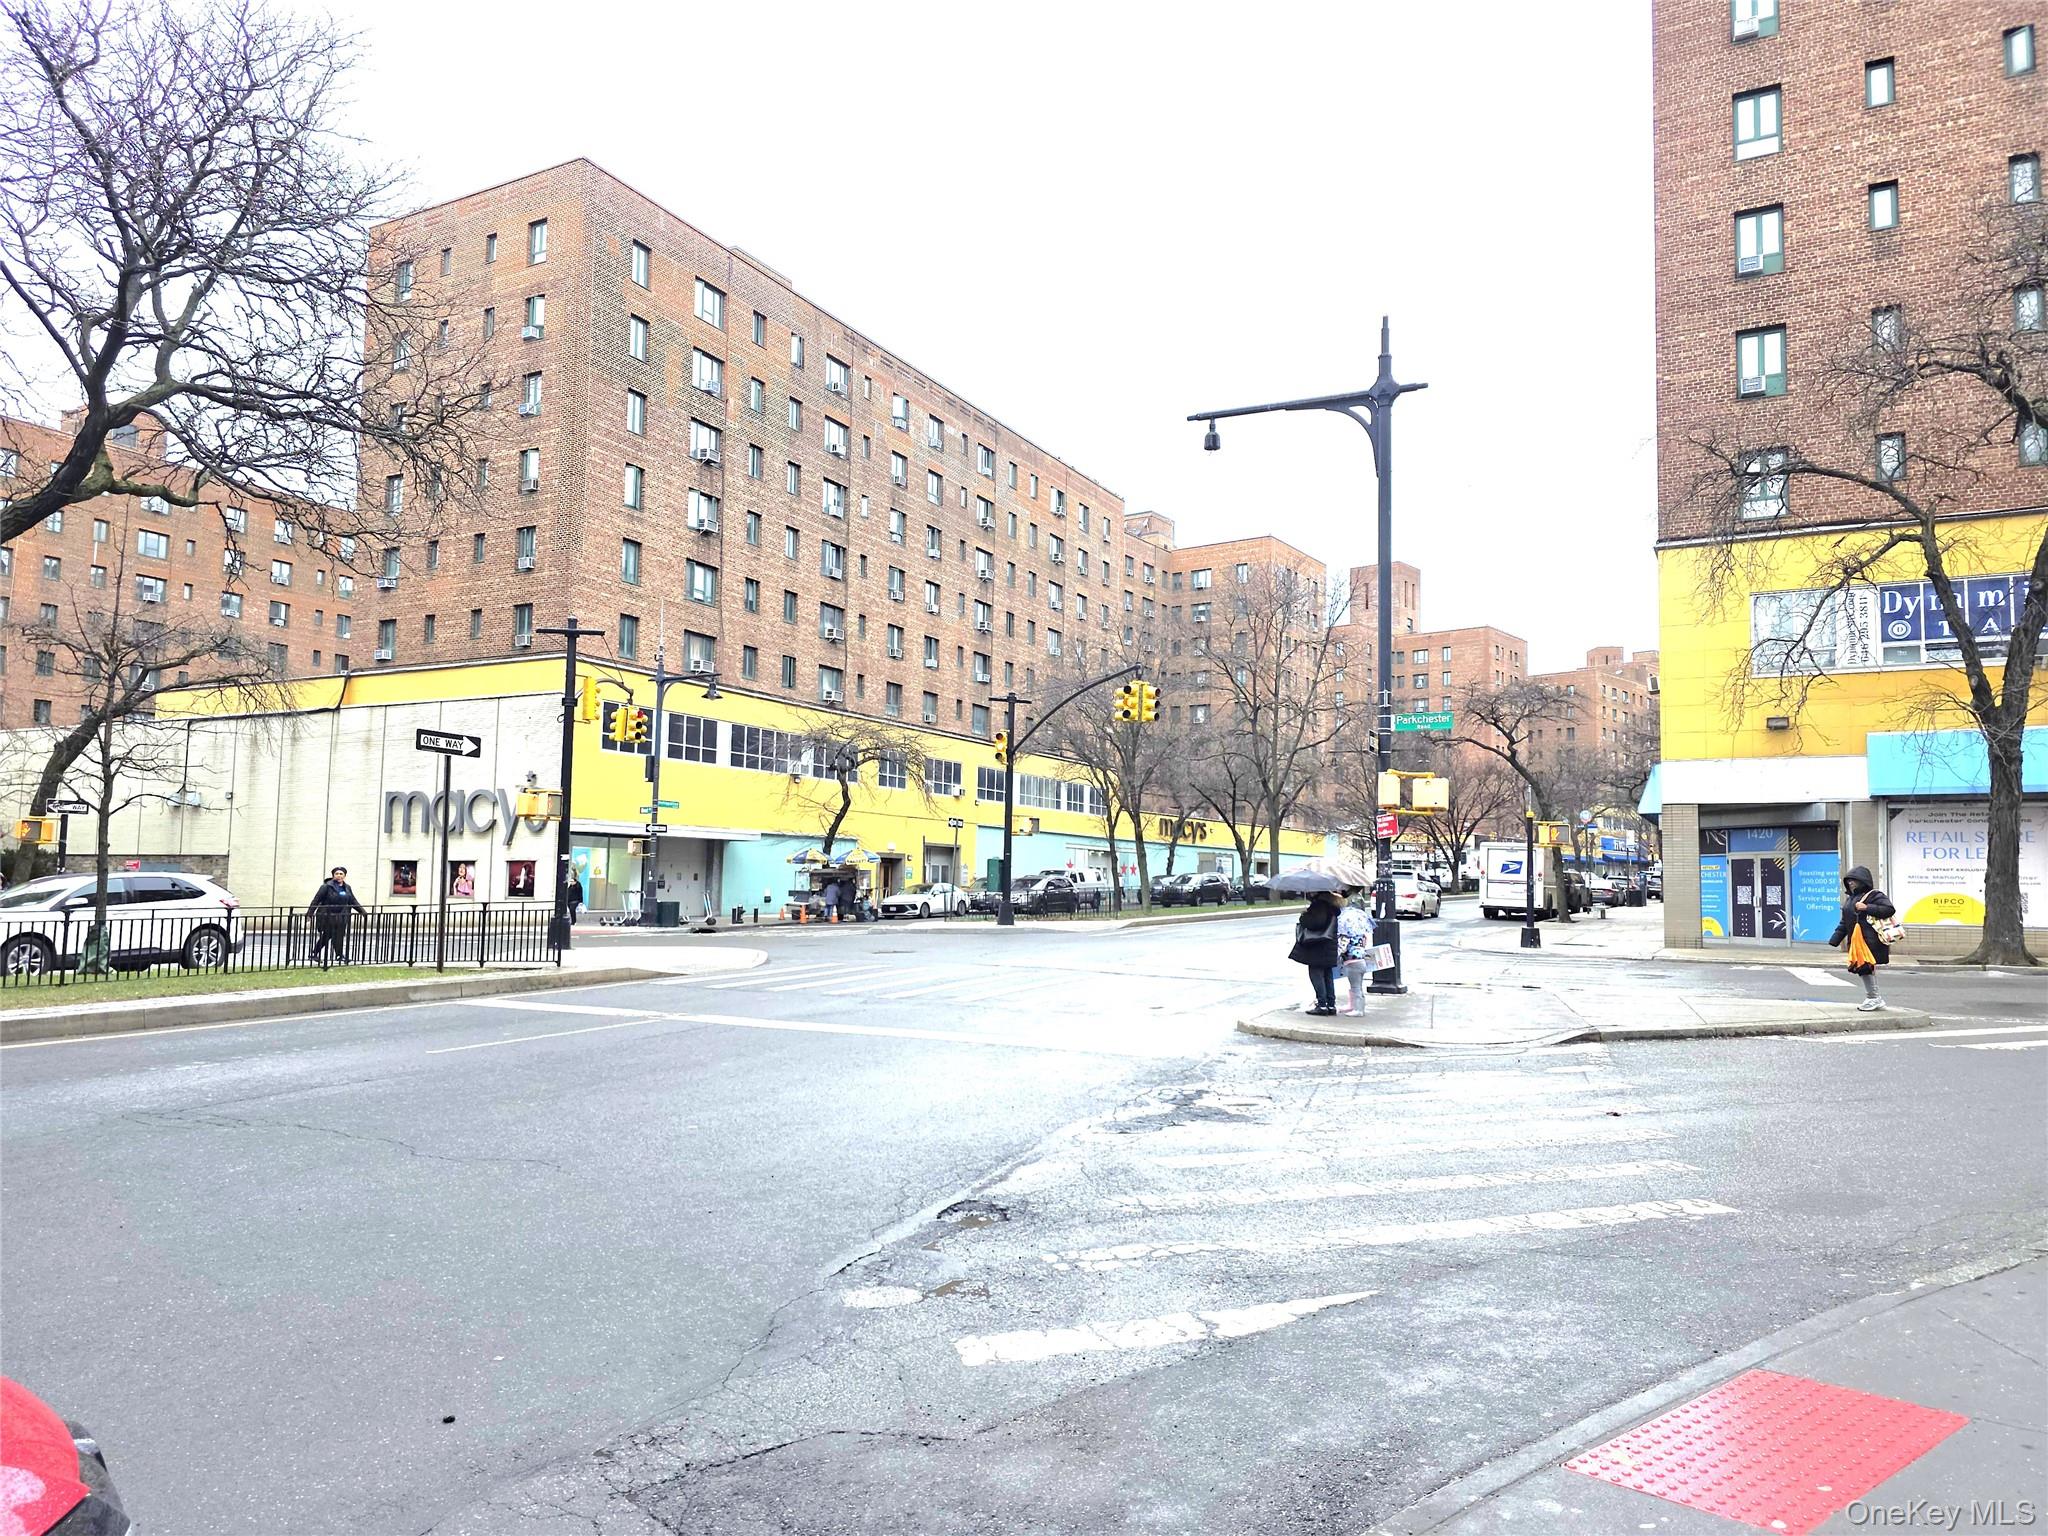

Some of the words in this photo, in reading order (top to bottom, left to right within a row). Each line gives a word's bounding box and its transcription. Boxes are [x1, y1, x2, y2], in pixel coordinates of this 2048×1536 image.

[1396, 714, 1451, 725] Parkchester
[422, 735, 441, 747] ONE
[445, 737, 464, 751] WAY
[1745, 828, 1773, 839] 1420
[1906, 831, 1968, 844] RETAIL
[1923, 848, 1960, 859] FOR
